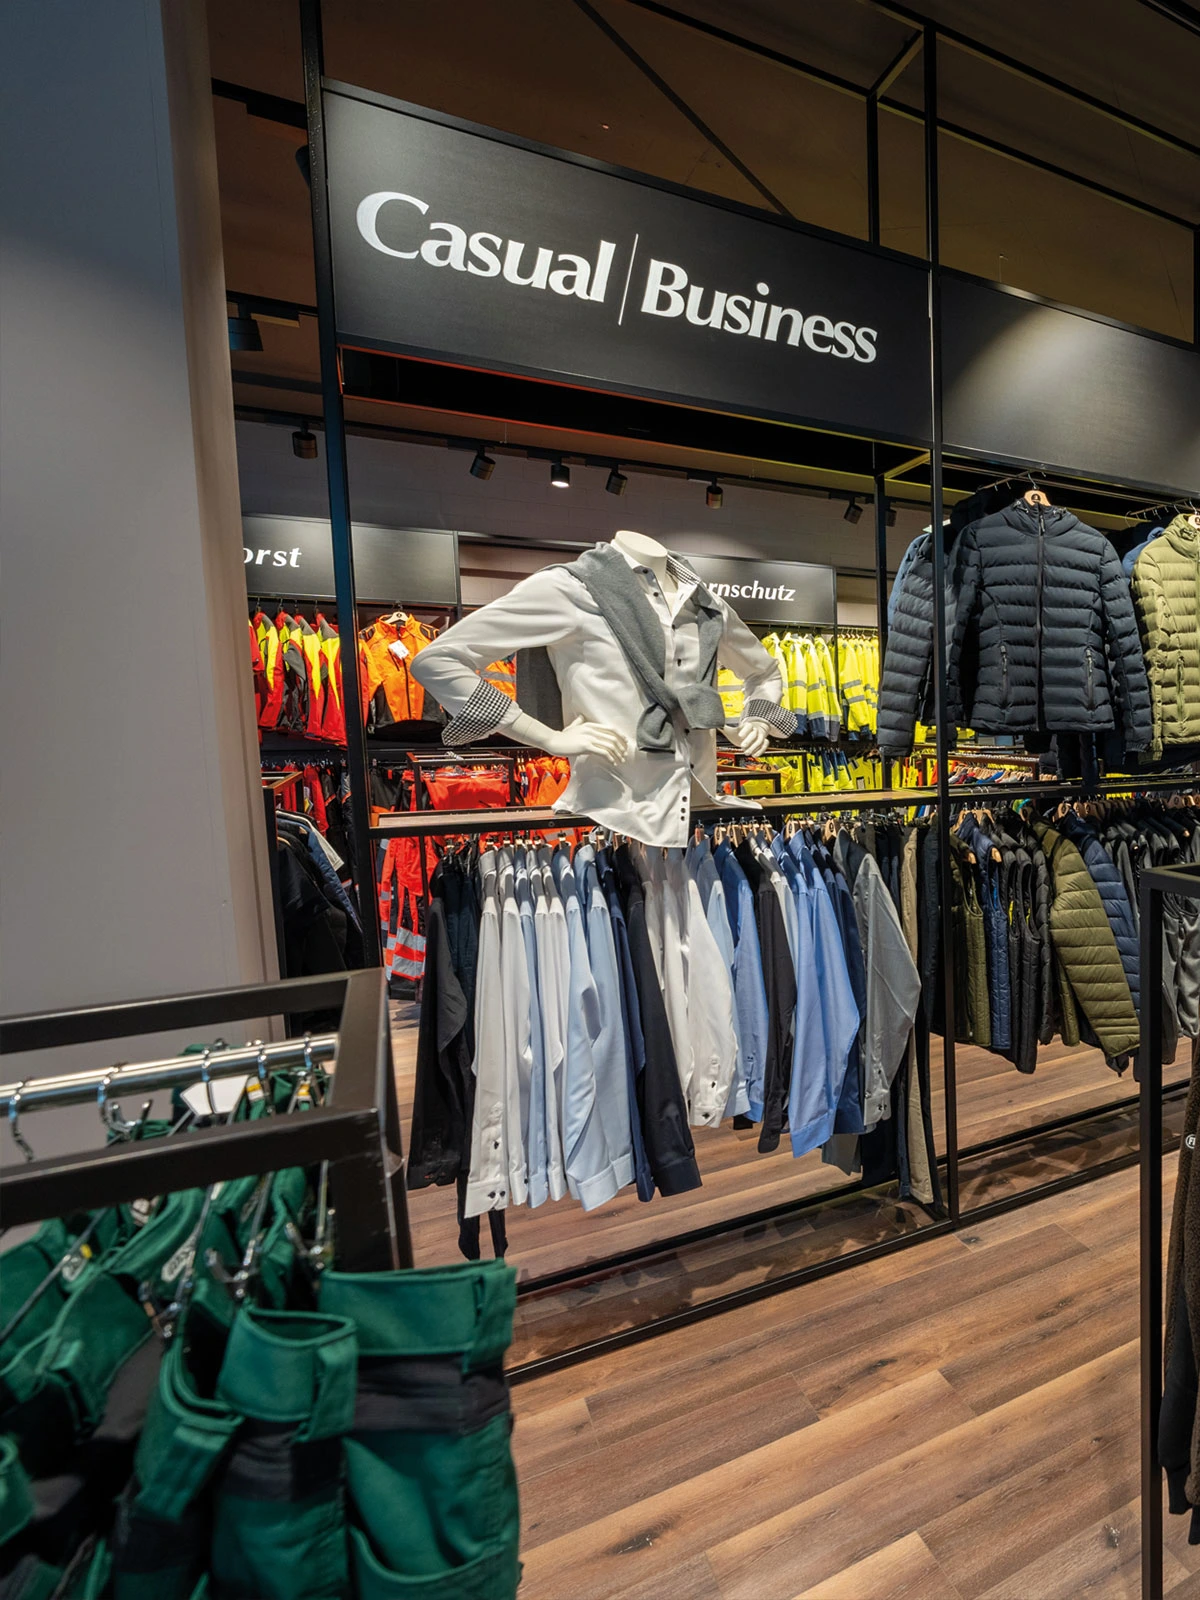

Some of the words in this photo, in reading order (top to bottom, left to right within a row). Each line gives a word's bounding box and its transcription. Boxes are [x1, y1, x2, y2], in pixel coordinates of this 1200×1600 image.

[356, 191, 615, 303] Casual
[641, 258, 878, 363] Business
[703, 580, 796, 602] rnschutz
